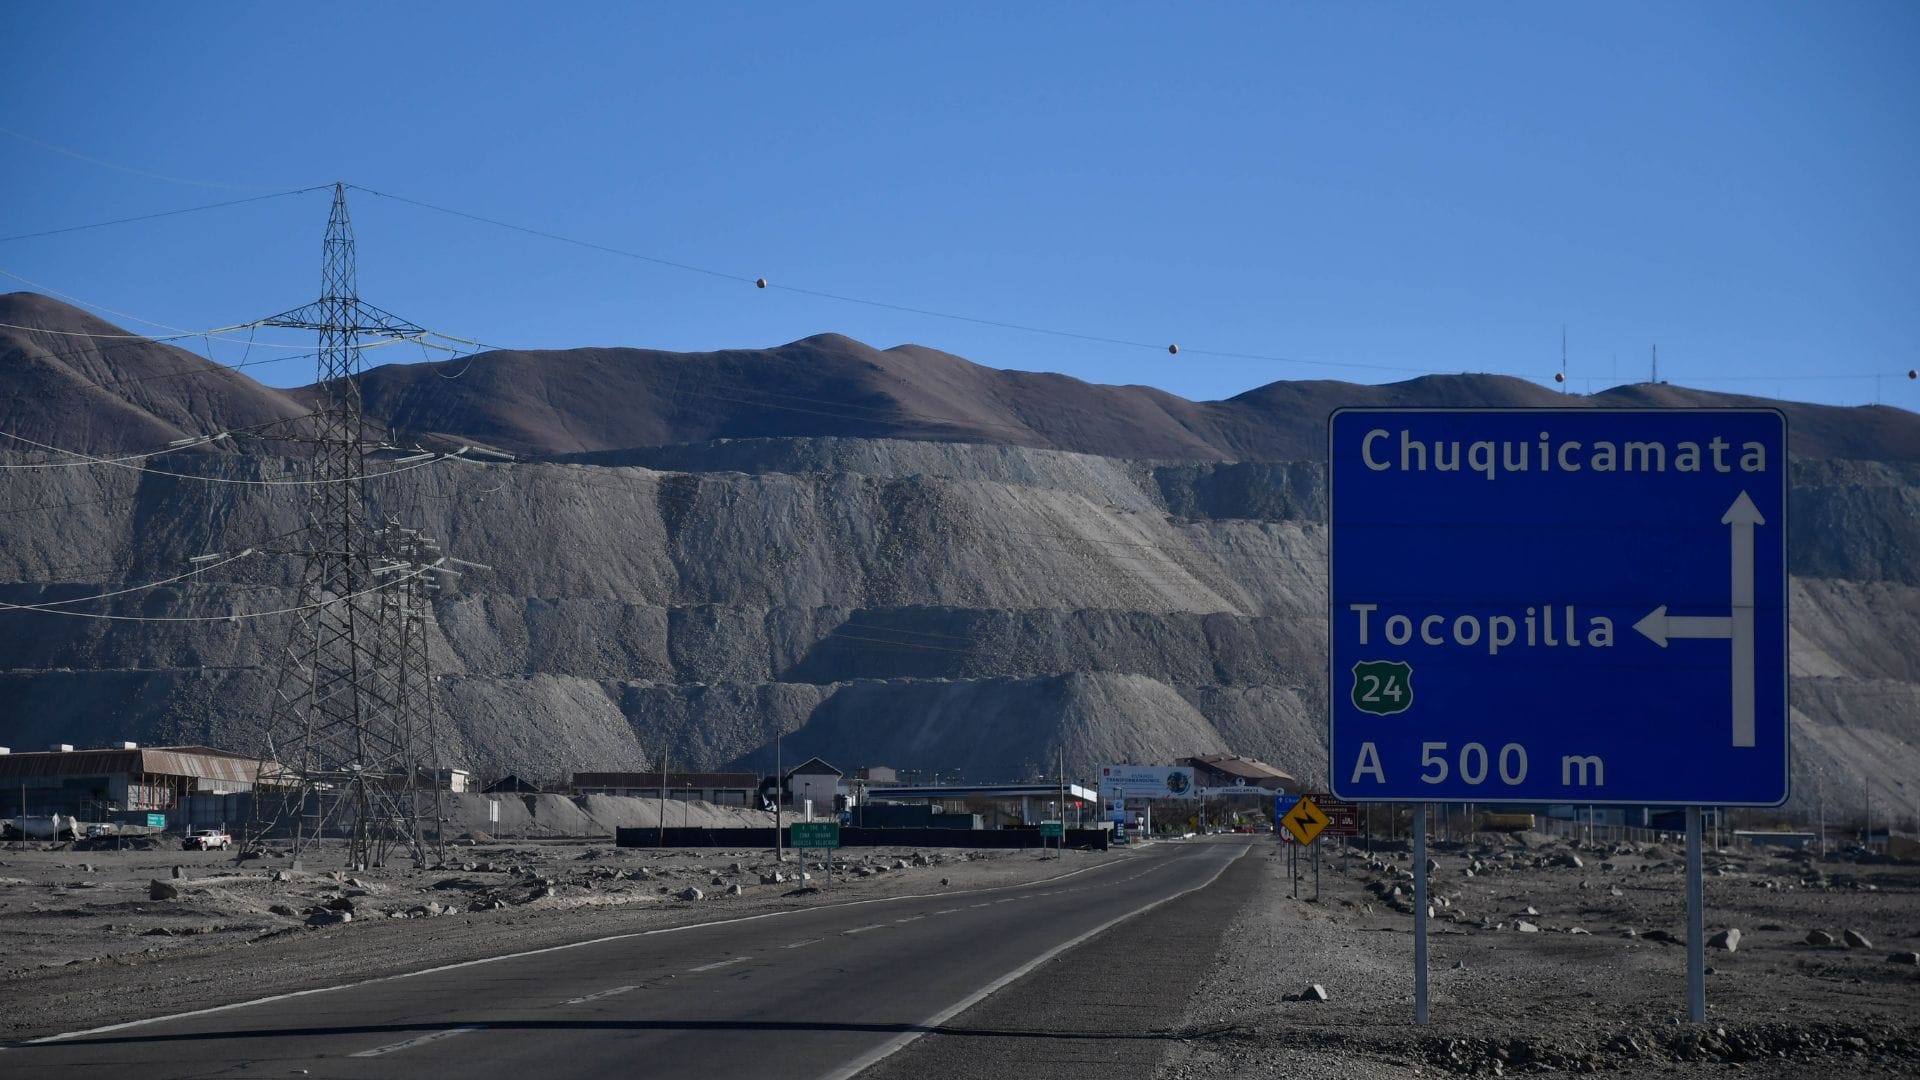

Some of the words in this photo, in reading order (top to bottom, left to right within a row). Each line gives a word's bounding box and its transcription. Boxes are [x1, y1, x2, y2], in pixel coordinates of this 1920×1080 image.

[1362, 429, 1766, 480] Chuquicamata
[1350, 604, 1614, 655] Tocopilla
[1362, 674, 1403, 702] 24
[1351, 742, 1386, 785] A
[1420, 742, 1528, 786] 500
[1562, 755, 1604, 786] m
